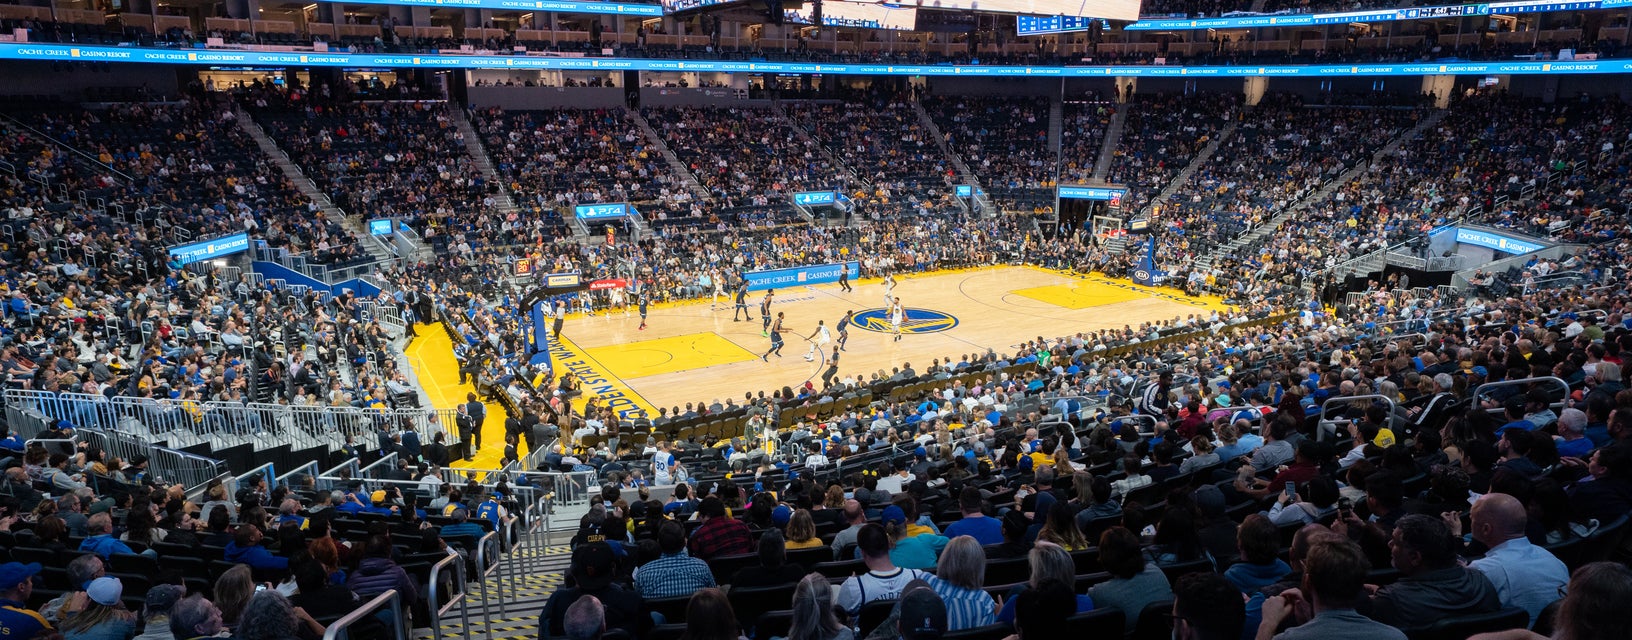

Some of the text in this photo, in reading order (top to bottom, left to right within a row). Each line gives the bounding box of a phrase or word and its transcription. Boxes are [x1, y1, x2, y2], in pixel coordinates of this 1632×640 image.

[1466, 6, 1475, 14] 51
[17, 48, 44, 56] CACHE
[598, 207, 622, 215] PS4
[1459, 232, 1481, 242] CACHE
[1481, 236, 1499, 246] CREEK
[1506, 241, 1526, 251] CASINO
[214, 242, 232, 252] CASINO
[517, 264, 527, 273] 20
[772, 275, 796, 284] CREEK
[807, 270, 833, 280] CASINO
[564, 360, 608, 385] STATE
[656, 462, 665, 471] 30
[480, 511, 488, 519] 6
